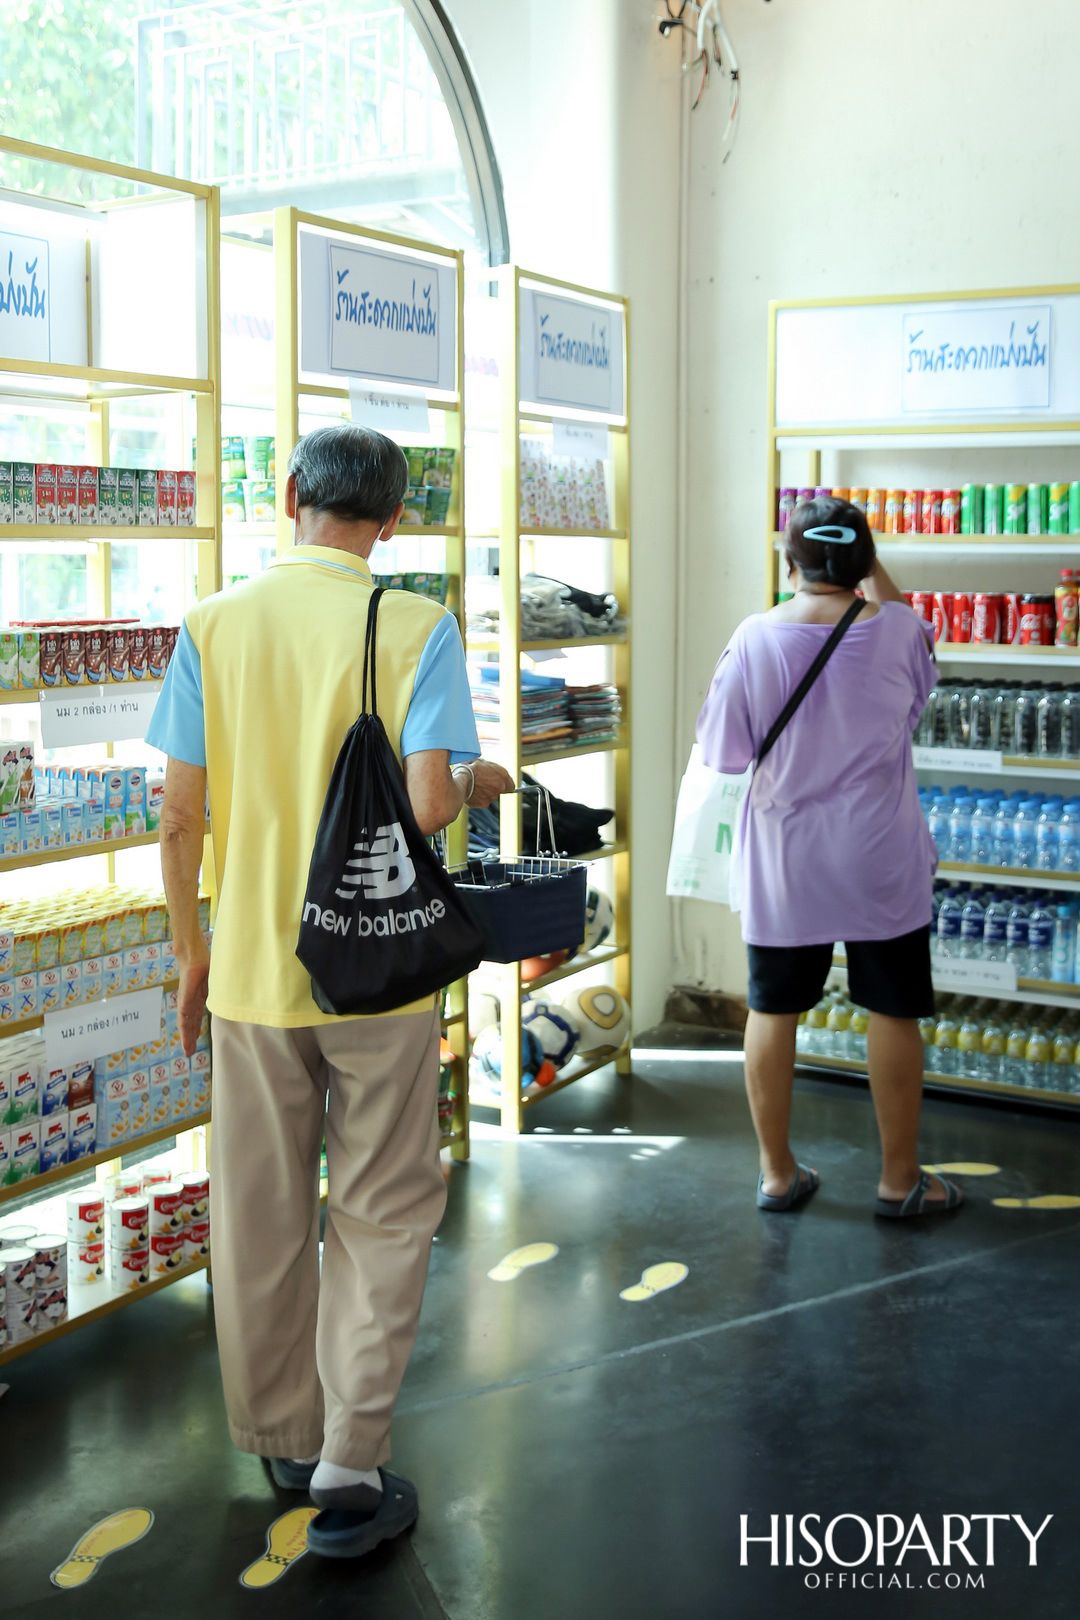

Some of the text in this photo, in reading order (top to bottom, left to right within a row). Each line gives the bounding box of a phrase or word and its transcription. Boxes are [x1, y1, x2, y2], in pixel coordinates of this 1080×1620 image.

[335, 268, 436, 337] ร้านสะดวกแบ่งปัน
[906, 320, 1047, 373] ร้านสะดวกแบ่งปัน
[56, 707, 71, 717] นม
[74, 706, 79, 716] 2
[82, 701, 106, 715] กล่อง
[120, 699, 139, 712] ท่าน
[302, 898, 446, 937] new balance
[61, 1027, 76, 1039] นม
[79, 1025, 84, 1035] 2
[87, 1017, 110, 1033] กล่อง
[122, 1010, 140, 1022] ท่าน
